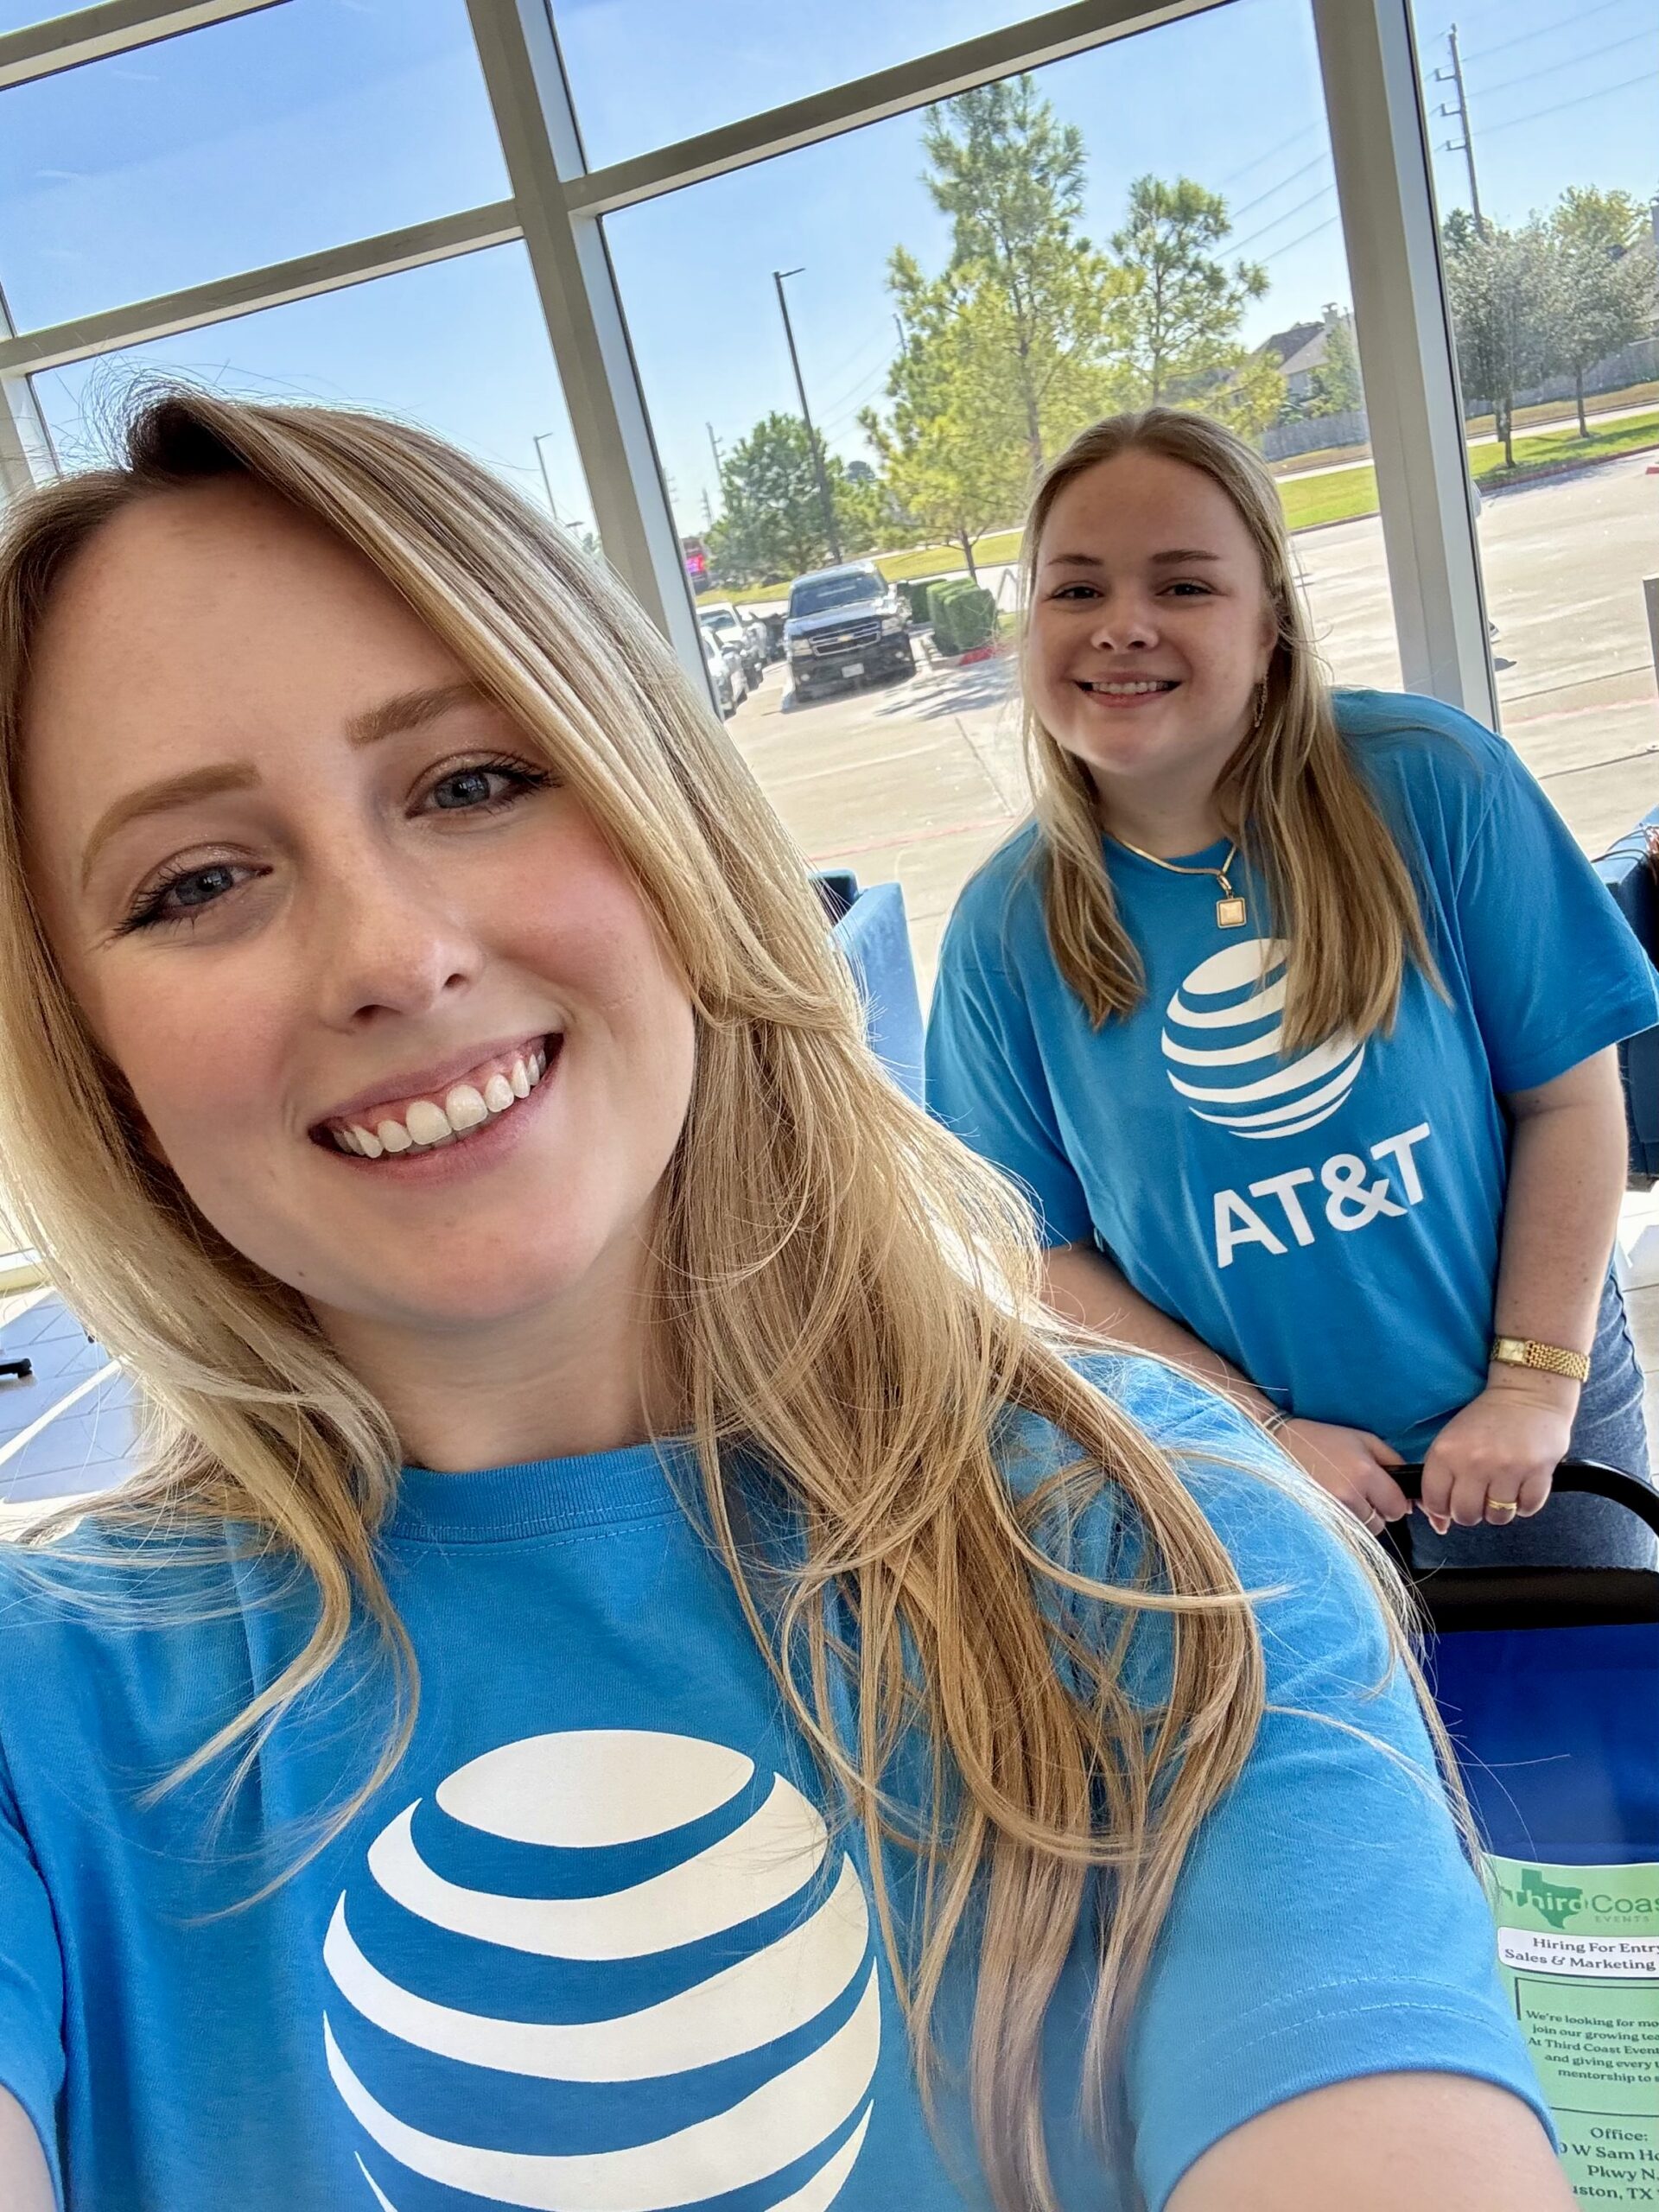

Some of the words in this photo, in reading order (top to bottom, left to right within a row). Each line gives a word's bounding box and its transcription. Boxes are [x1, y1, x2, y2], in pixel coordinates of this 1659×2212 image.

[1213, 1122, 1430, 1268] AT&T
[1533, 1937, 1586, 1954] Hiring
[1589, 1942, 1615, 1953] For
[1504, 1948, 1548, 1964] Sales
[1551, 1956, 1566, 1966] &
[1570, 1957, 1656, 1971] Marketing
[1526, 2010, 1562, 2023] We're
[1566, 2015, 1613, 2028] looking
[1616, 2018, 1636, 2027] for
[1533, 2024, 1557, 2035] join
[1560, 2029, 1582, 2037] our
[1586, 2031, 1640, 2042] growing
[1528, 2037, 1541, 2046] At
[1545, 2039, 1581, 2051] Third
[1583, 2043, 1621, 2054] Coast
[1544, 2054, 1569, 2063] and
[1573, 2056, 1614, 2069] giving
[1616, 2061, 1653, 2070] every
[1558, 2069, 1636, 2083] mentorship
[1637, 2074, 1649, 2082] to
[1590, 2127, 1649, 2141] Office:
[1572, 2143, 1592, 2156] W
[1595, 2146, 1635, 2160] Sam
[1587, 2164, 1637, 2182] Pkwy
[1626, 2188, 1654, 2200] TX
